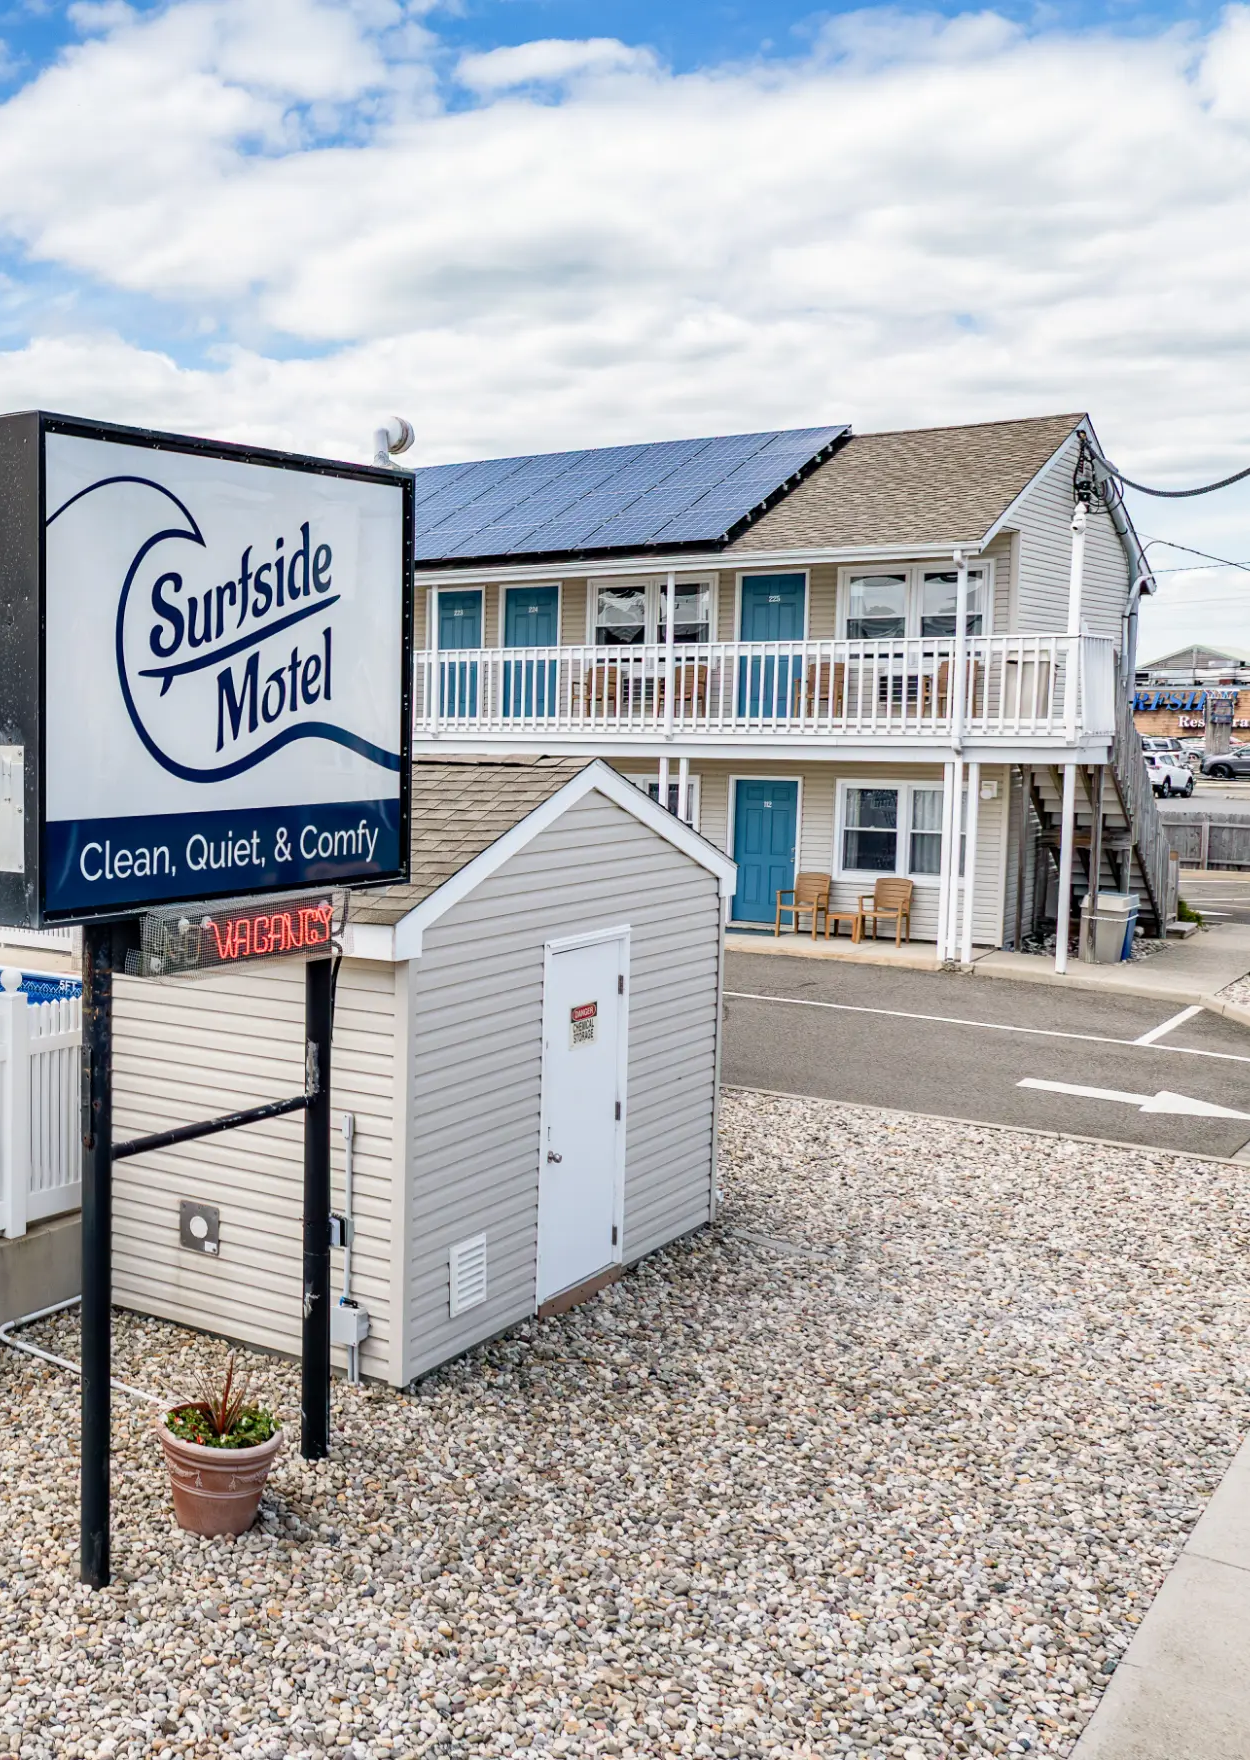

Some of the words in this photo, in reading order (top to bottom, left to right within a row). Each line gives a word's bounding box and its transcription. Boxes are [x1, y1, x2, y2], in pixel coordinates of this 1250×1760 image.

[149, 520, 333, 658] Surfside
[215, 626, 332, 754] Motel
[79, 841, 177, 882] Clean,
[185, 829, 267, 871] Quiet,
[274, 827, 293, 863] &
[299, 820, 379, 864] Comfy
[205, 904, 335, 960] VACANCY
[572, 1018, 595, 1033] CHEMICAL
[573, 1028, 594, 1044] STORAGE
[574, 1006, 594, 1019] DANGER
